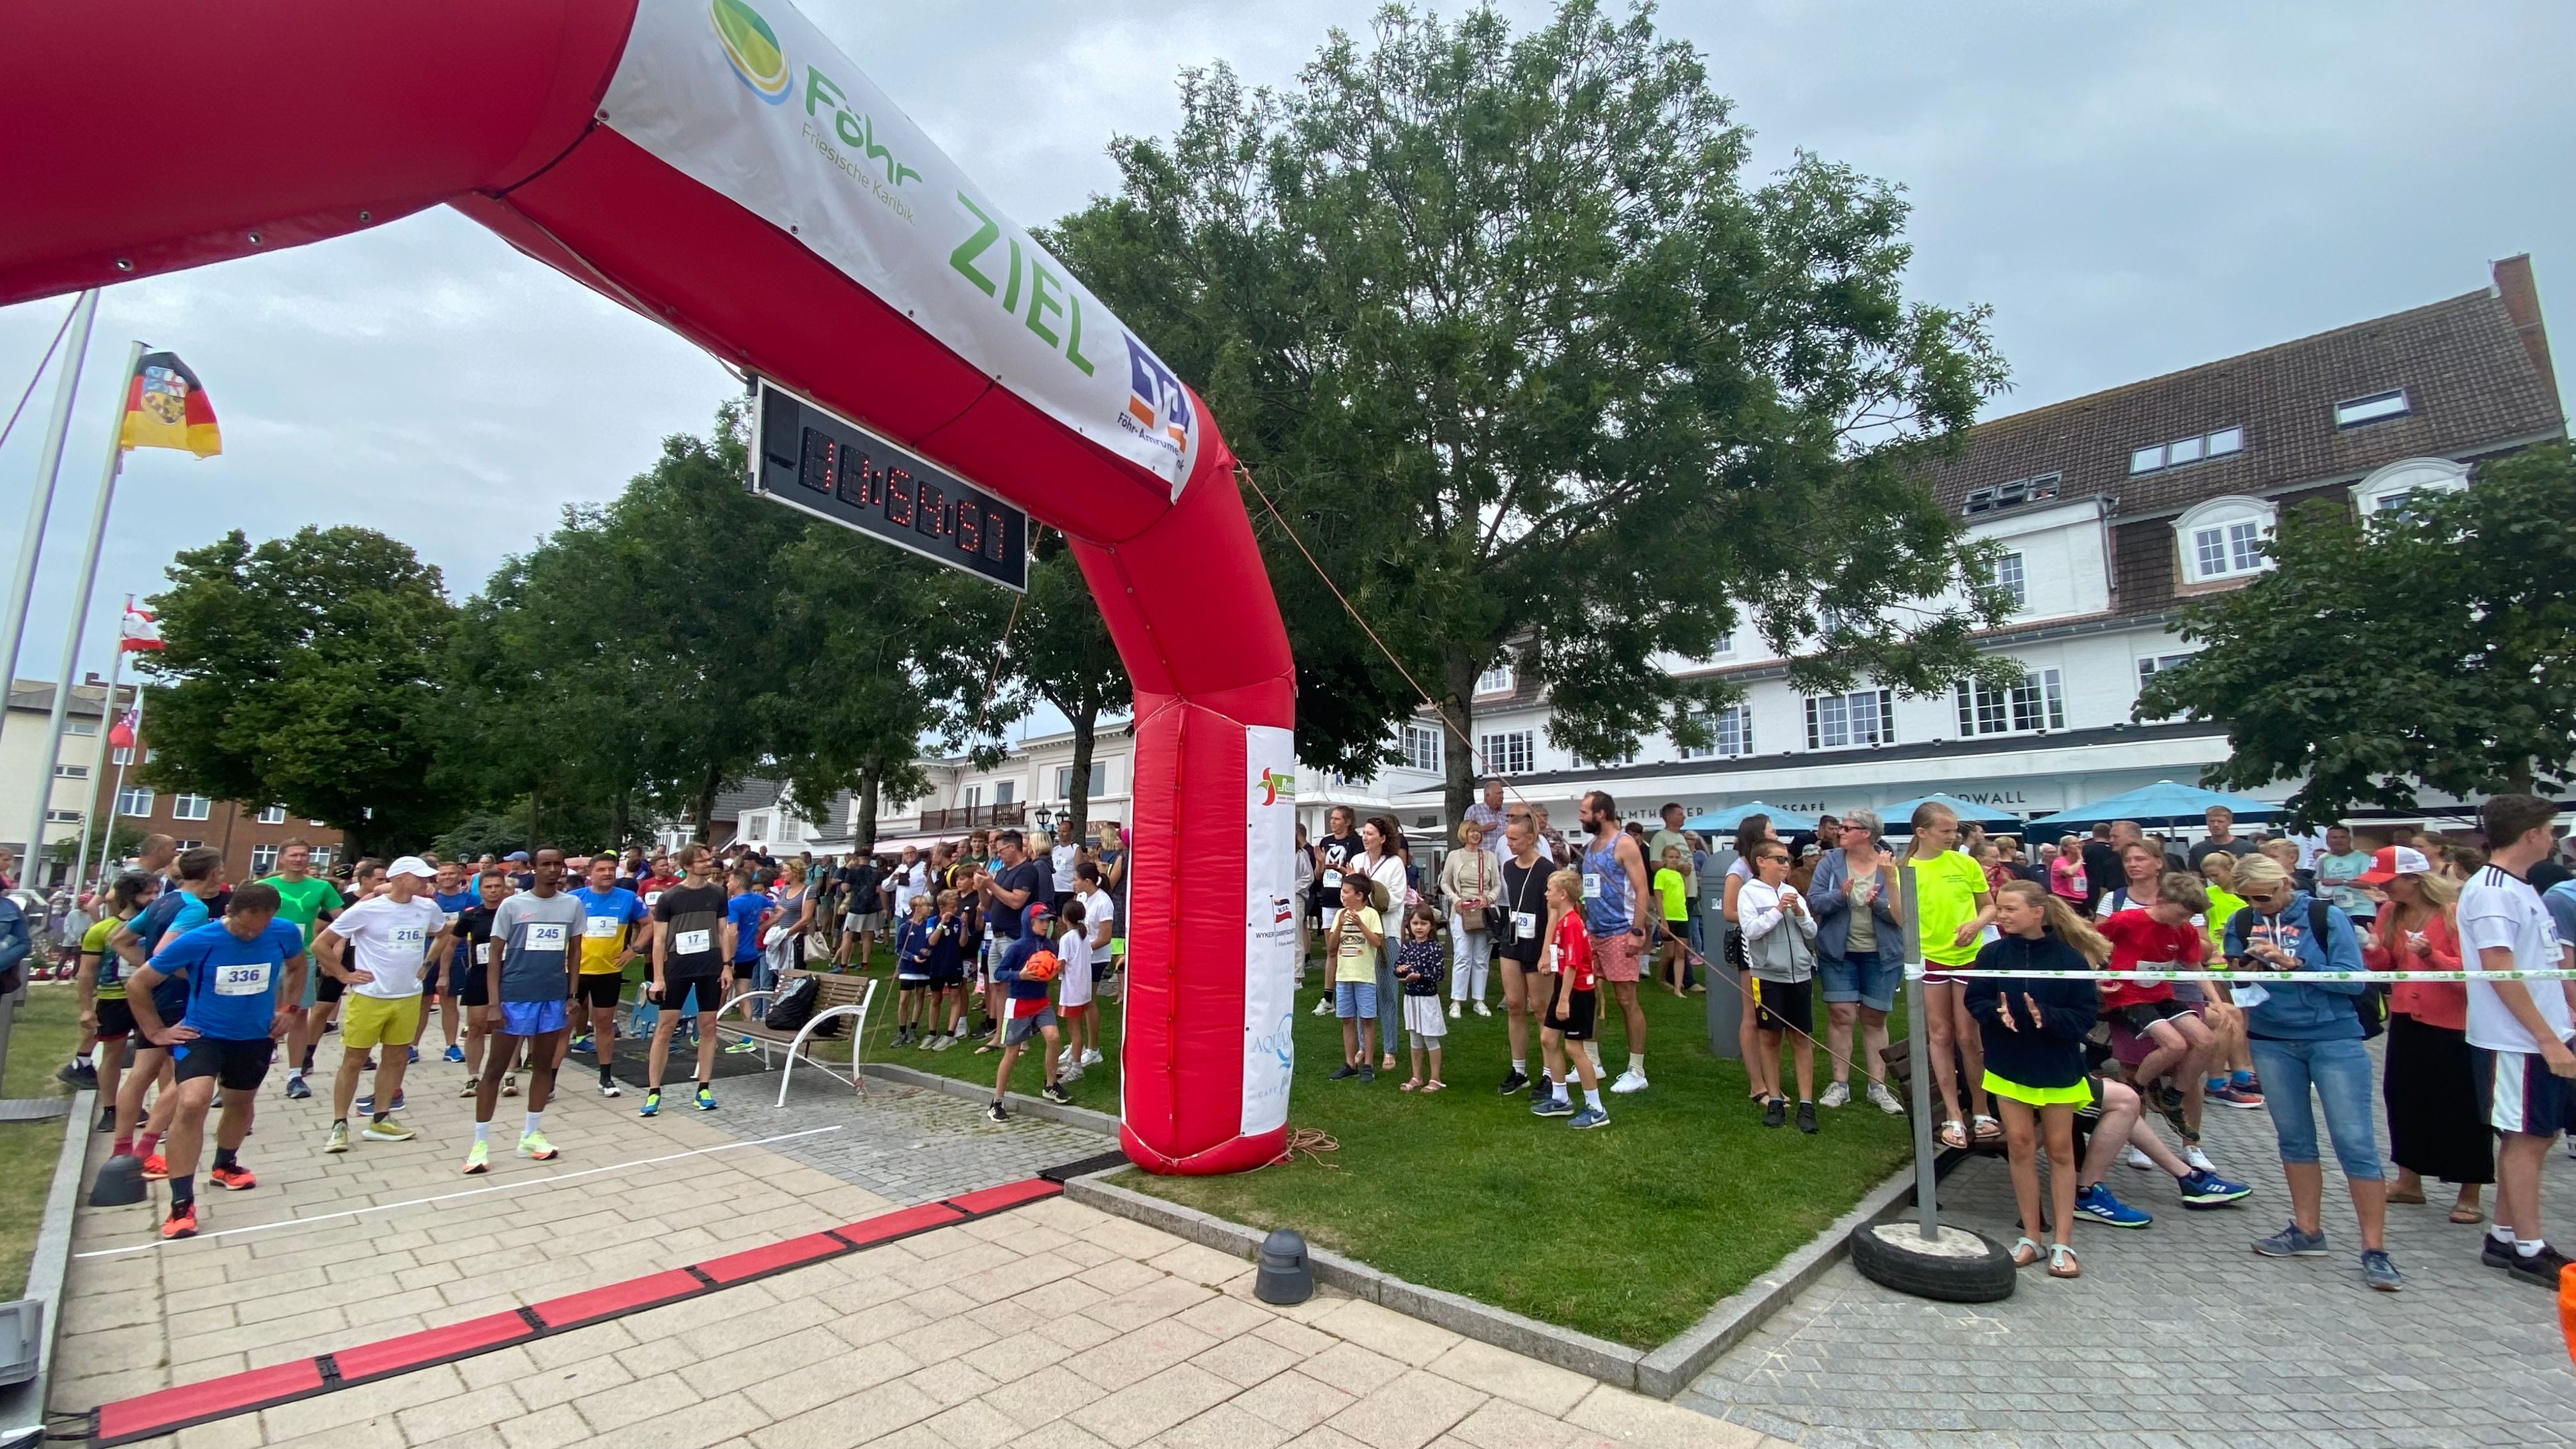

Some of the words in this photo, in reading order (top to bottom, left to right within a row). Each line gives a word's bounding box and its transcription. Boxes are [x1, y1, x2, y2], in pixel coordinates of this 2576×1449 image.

[806, 65, 922, 187] Föhr
[802, 122, 870, 189] Friesische
[873, 180, 916, 226] Karibik.
[949, 189, 1094, 378] ZIEL
[599, 920, 606, 928] 3
[1517, 916, 1528, 926] 29
[397, 930, 420, 940] 216
[536, 928, 558, 939] 245
[687, 934, 699, 944] 17
[228, 969, 260, 983] 336
